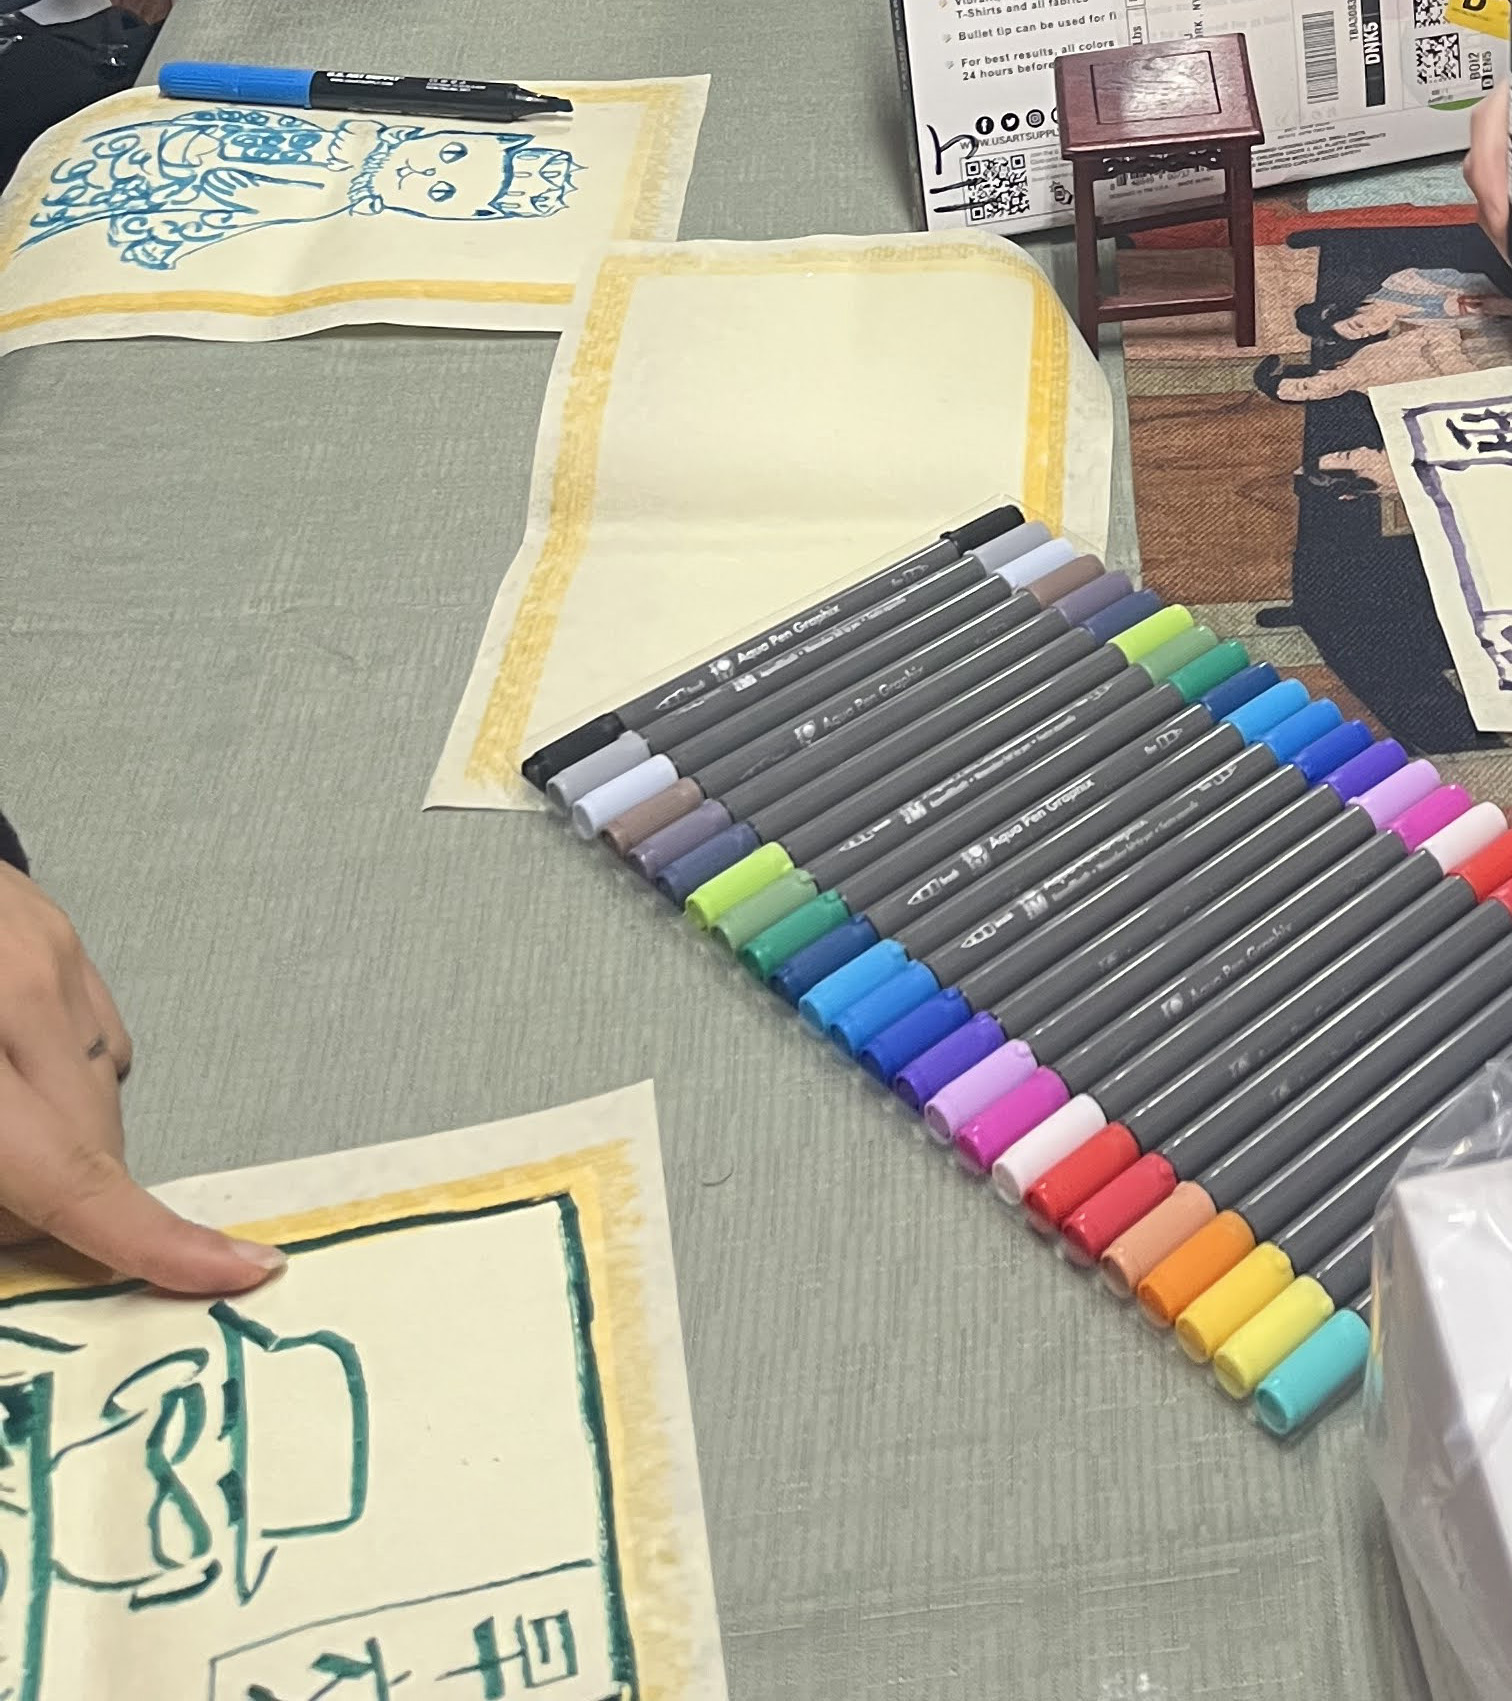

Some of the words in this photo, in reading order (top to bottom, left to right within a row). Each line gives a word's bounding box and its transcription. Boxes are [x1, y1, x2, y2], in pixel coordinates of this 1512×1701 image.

[955, 7, 1002, 19] T-Shirts
[1006, 2, 1027, 13] and
[1031, 0, 1045, 9] all
[958, 28, 993, 41] Bullet
[996, 26, 1012, 36] tip
[1015, 24, 1037, 33] can
[1040, 21, 1054, 30] be
[1057, 15, 1086, 28] used
[1089, 14, 1106, 23] for
[961, 58, 981, 68] For
[984, 53, 1010, 64] best
[1013, 48, 1058, 60] results,
[1061, 44, 1075, 54] all
[1078, 40, 1115, 51] colors
[1363, 21, 1381, 65] DNK5
[962, 71, 976, 81] 24
[980, 67, 1014, 78] hours
[737, 641, 770, 665] Aqua
[768, 629, 794, 647] Pen
